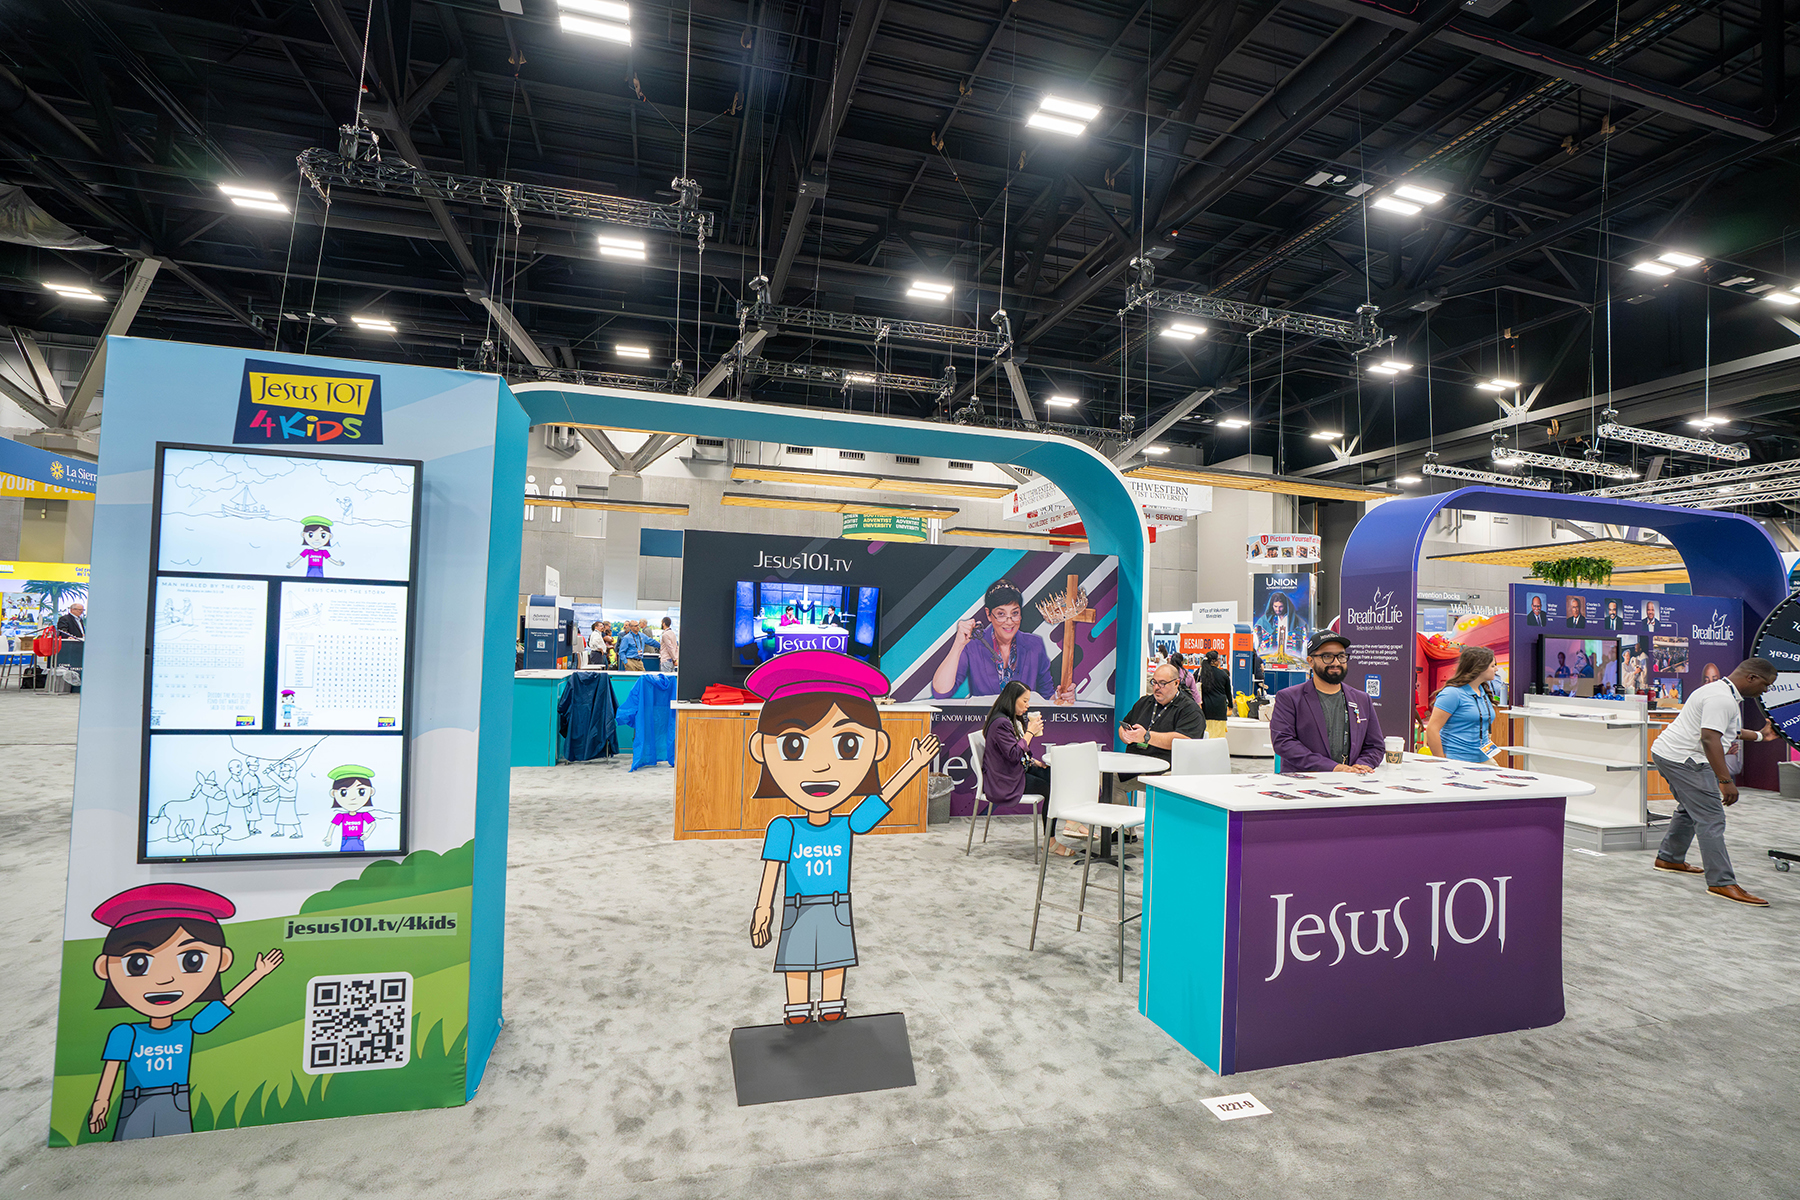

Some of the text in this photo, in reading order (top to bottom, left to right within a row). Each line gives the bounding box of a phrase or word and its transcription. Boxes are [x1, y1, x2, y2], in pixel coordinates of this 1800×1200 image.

[258, 376, 318, 403] Jesus
[1150, 492, 1189, 502] UNIVERSITY
[1266, 577, 1298, 586] UNION
[1348, 606, 1376, 624] Breath
[1377, 610, 1384, 623] of
[1385, 604, 1403, 624] Life
[1450, 603, 1472, 614] Walla
[1473, 605, 1494, 615] Walla
[1692, 624, 1715, 639] Breath
[1721, 625, 1734, 641] Life
[776, 636, 817, 652] Jesus
[941, 713, 963, 721] KNOW
[965, 713, 983, 722] HOW
[1050, 713, 1078, 723] JESUS
[1082, 713, 1108, 722] WINS!
[793, 844, 842, 858] Jesus
[805, 859, 832, 876] 101
[285, 915, 456, 939] jesus101.tv/4kids
[1265, 893, 1410, 982] Jesus
[134, 1043, 183, 1058] Jesus
[145, 1056, 173, 1072] 101
